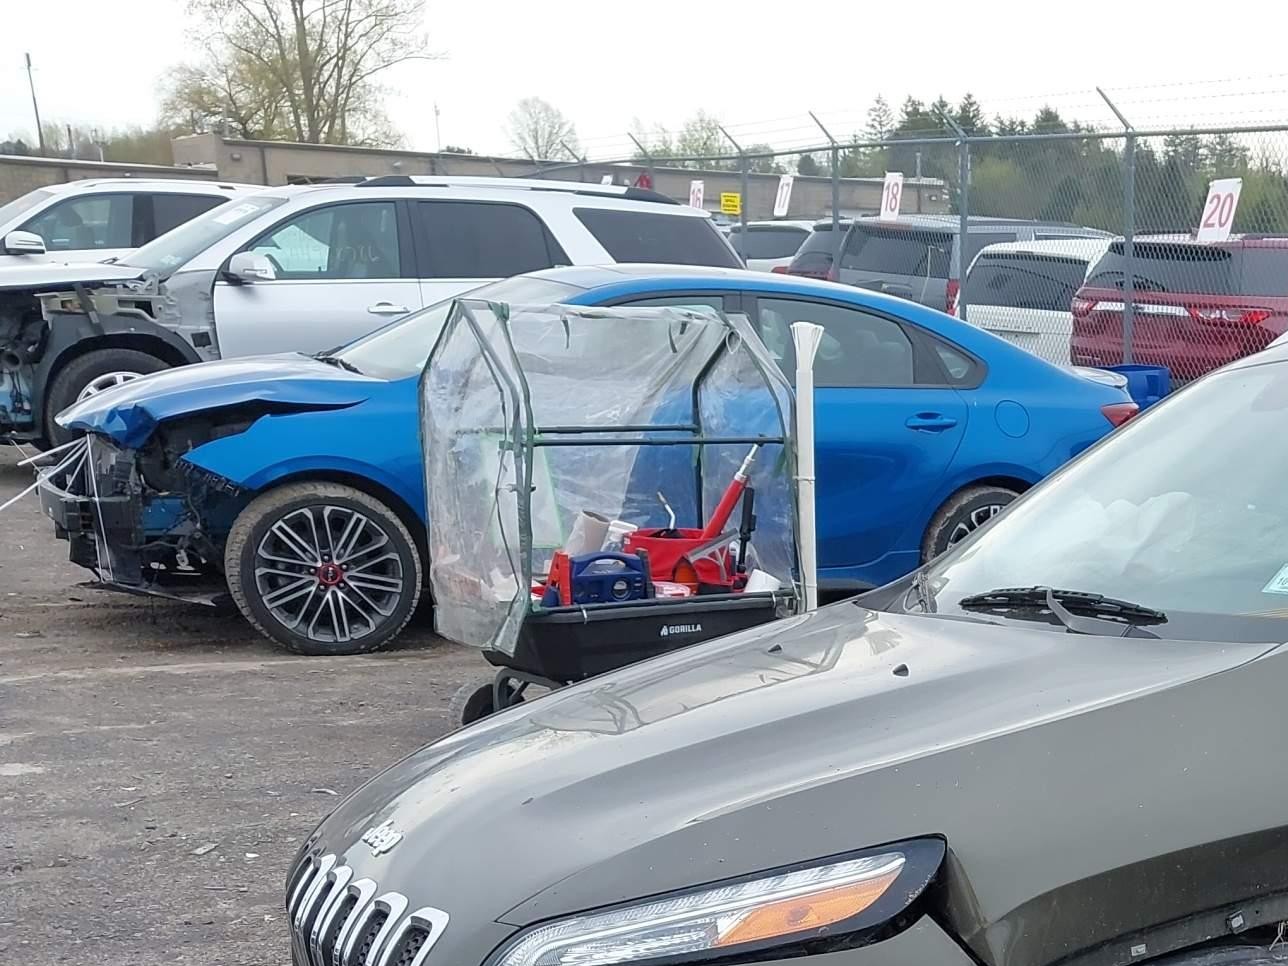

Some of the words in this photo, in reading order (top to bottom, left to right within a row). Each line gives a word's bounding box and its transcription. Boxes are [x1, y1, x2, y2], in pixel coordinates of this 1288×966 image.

[777, 182, 790, 208] 17
[885, 182, 900, 212] 18
[1203, 192, 1234, 228] 20
[669, 624, 702, 634] GORILLA
[361, 819, 404, 857] Jeep
